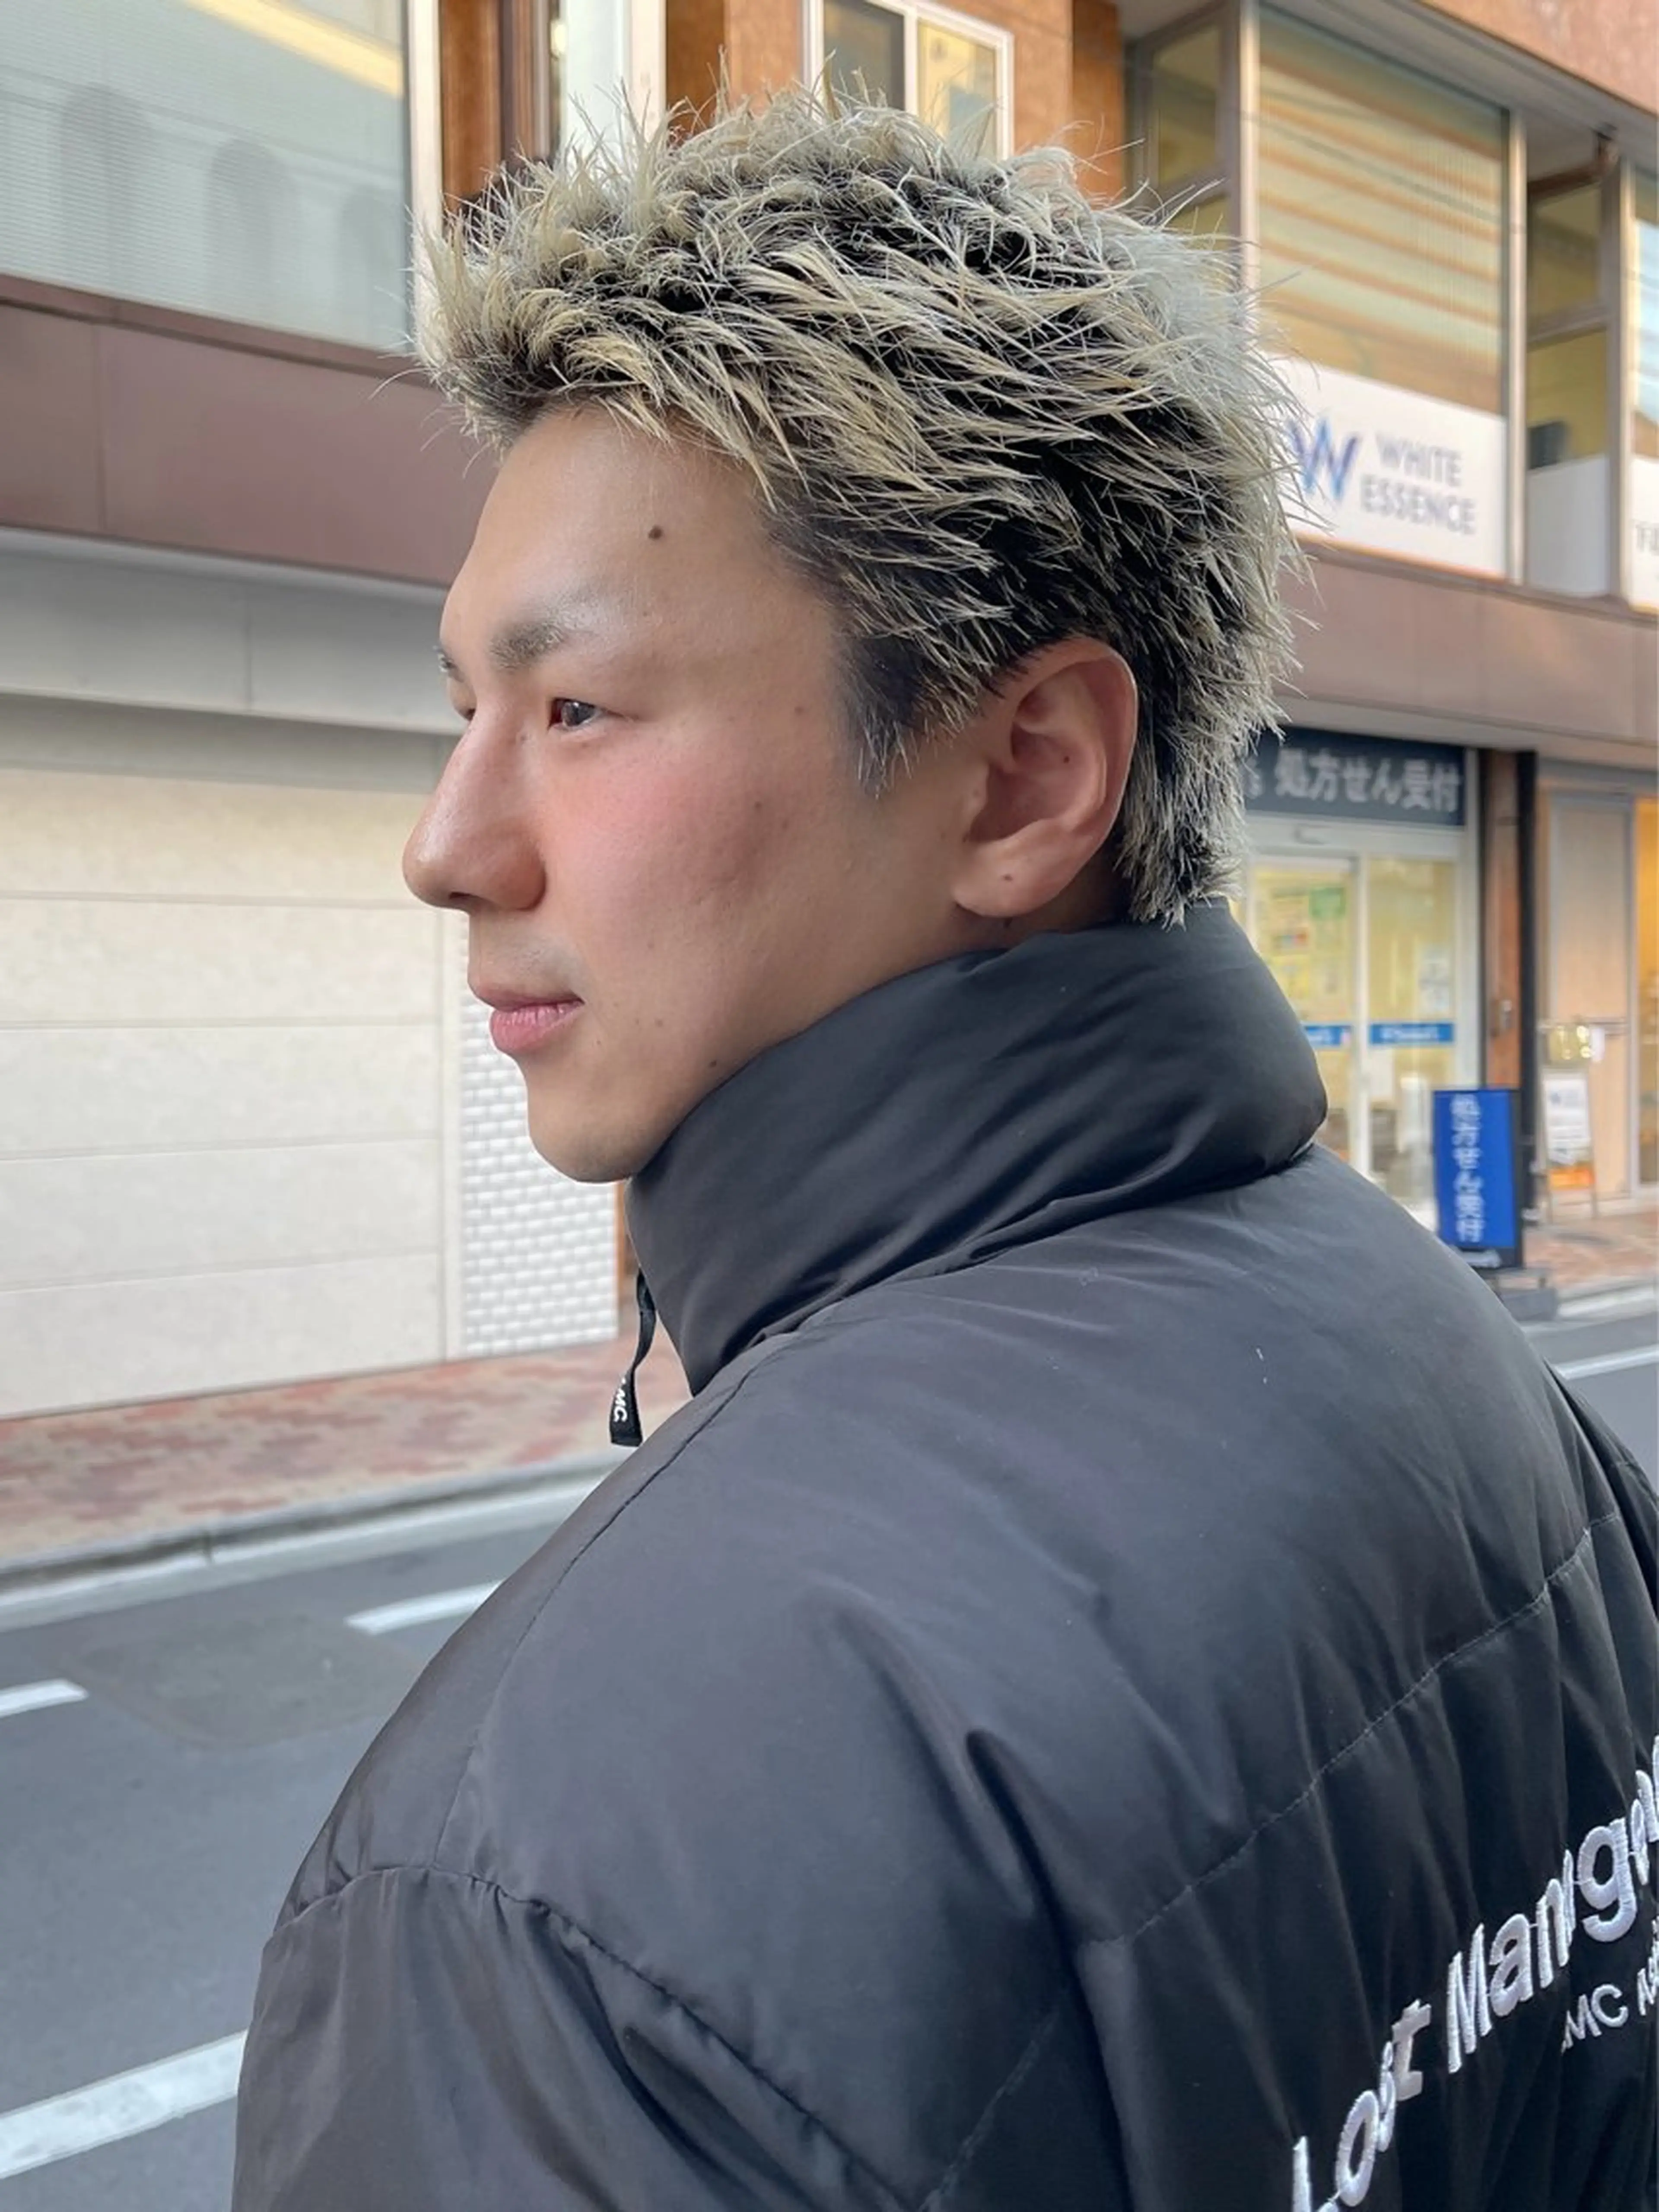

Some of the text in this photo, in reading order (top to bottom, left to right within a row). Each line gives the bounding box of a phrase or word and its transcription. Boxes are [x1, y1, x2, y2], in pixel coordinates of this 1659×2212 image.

[1376, 432, 1462, 486] WHITE
[1360, 474, 1476, 536] ESSENCE
[1275, 747, 1459, 812] 処方せん受付
[614, 1376, 628, 1422] MC
